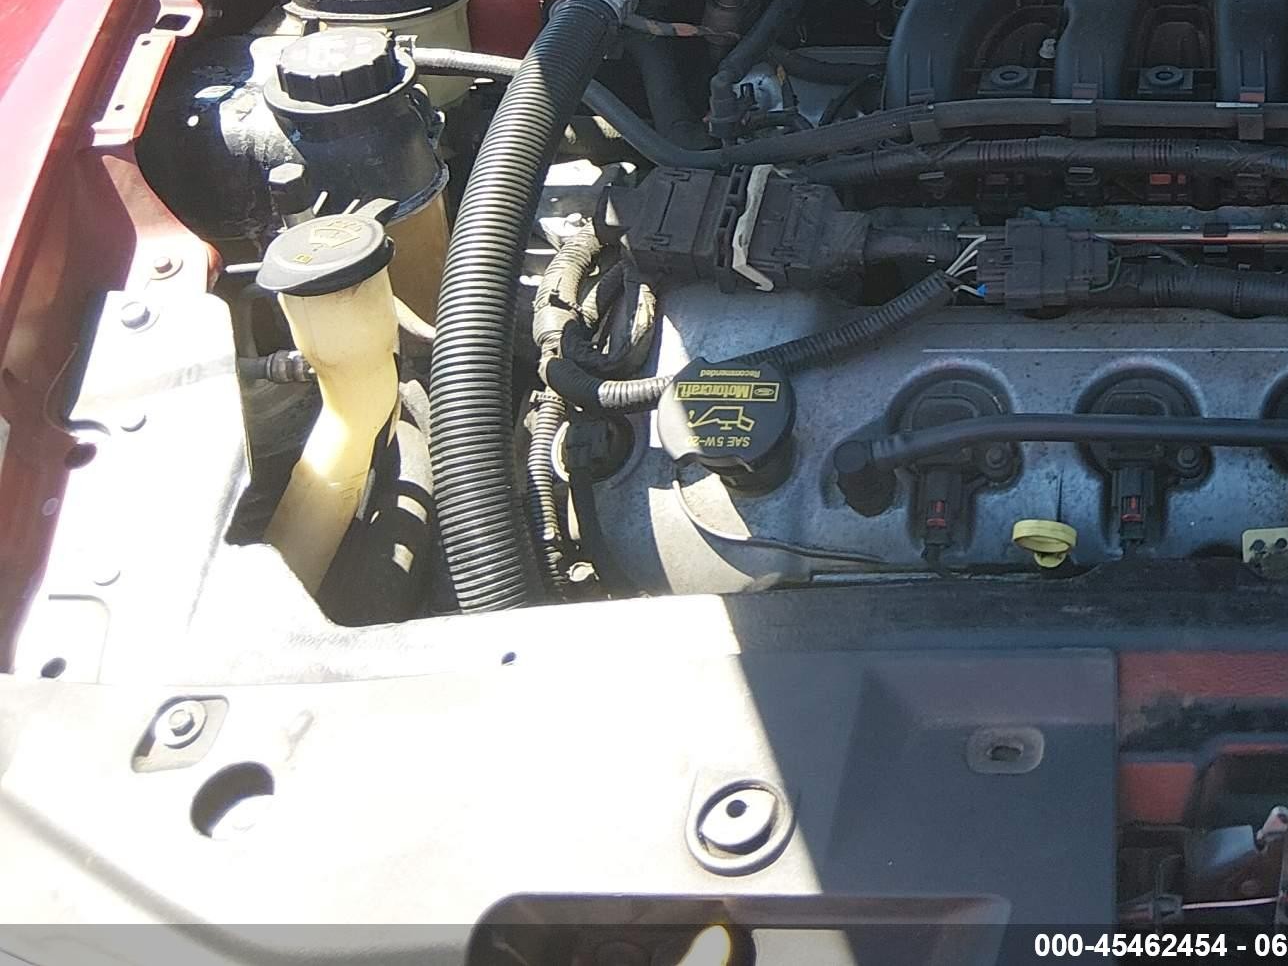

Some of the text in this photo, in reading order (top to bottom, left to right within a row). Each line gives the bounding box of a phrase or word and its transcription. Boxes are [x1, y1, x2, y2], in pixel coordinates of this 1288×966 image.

[700, 369, 761, 379] Recommended
[679, 384, 750, 399] Motorcraft
[726, 436, 751, 448] SAE
